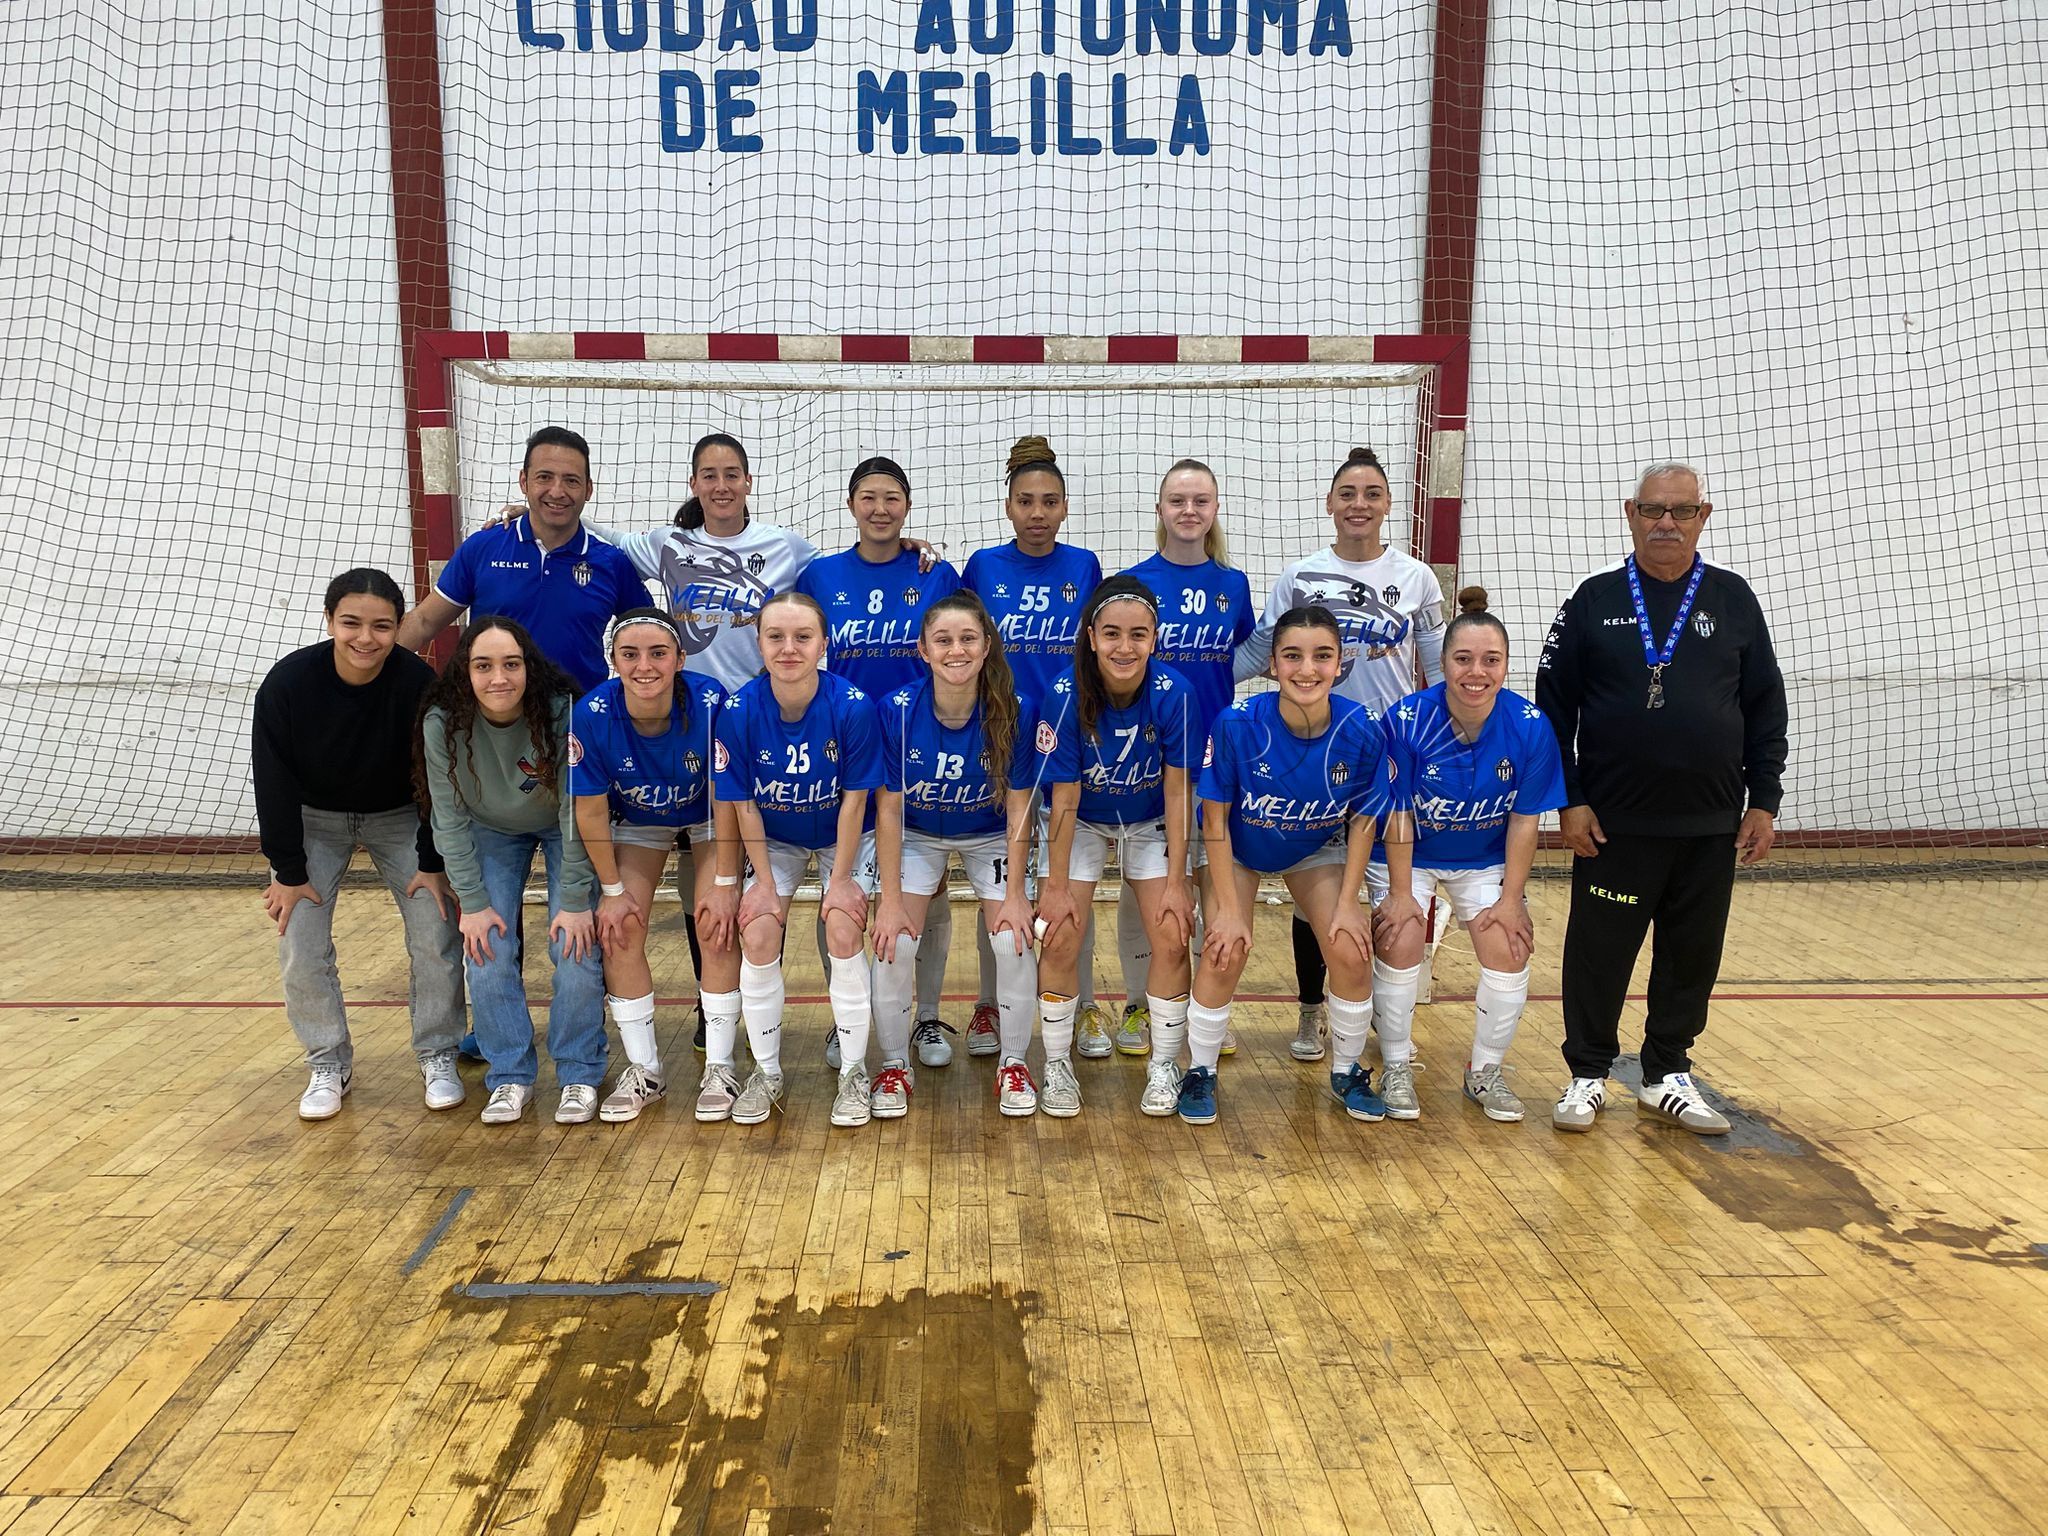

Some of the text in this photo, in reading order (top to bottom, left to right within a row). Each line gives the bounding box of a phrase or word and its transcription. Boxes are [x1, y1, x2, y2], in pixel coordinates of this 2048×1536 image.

[659, 69, 1211, 156] DE MELILLA
[491, 560, 529, 569] KELME
[867, 588, 884, 615] 8
[1018, 585, 1051, 612] 55
[1180, 587, 1207, 615] 30
[1349, 582, 1366, 607] 3
[831, 619, 920, 648] MELILL
[1603, 616, 1638, 626] KELM
[867, 648, 885, 658] DEL
[1025, 643, 1042, 654] DEL
[1179, 652, 1197, 662] DEL
[1343, 647, 1361, 657] DEL
[1114, 725, 1140, 762] 7
[785, 741, 811, 774] 25
[934, 751, 965, 780] 13
[753, 775, 842, 804] MELILL
[902, 778, 997, 804] MELILL
[1109, 786, 1128, 795] DEL
[1281, 821, 1300, 831] DEL
[1450, 823, 1470, 831] DEL
[1589, 884, 1639, 905] KELME
